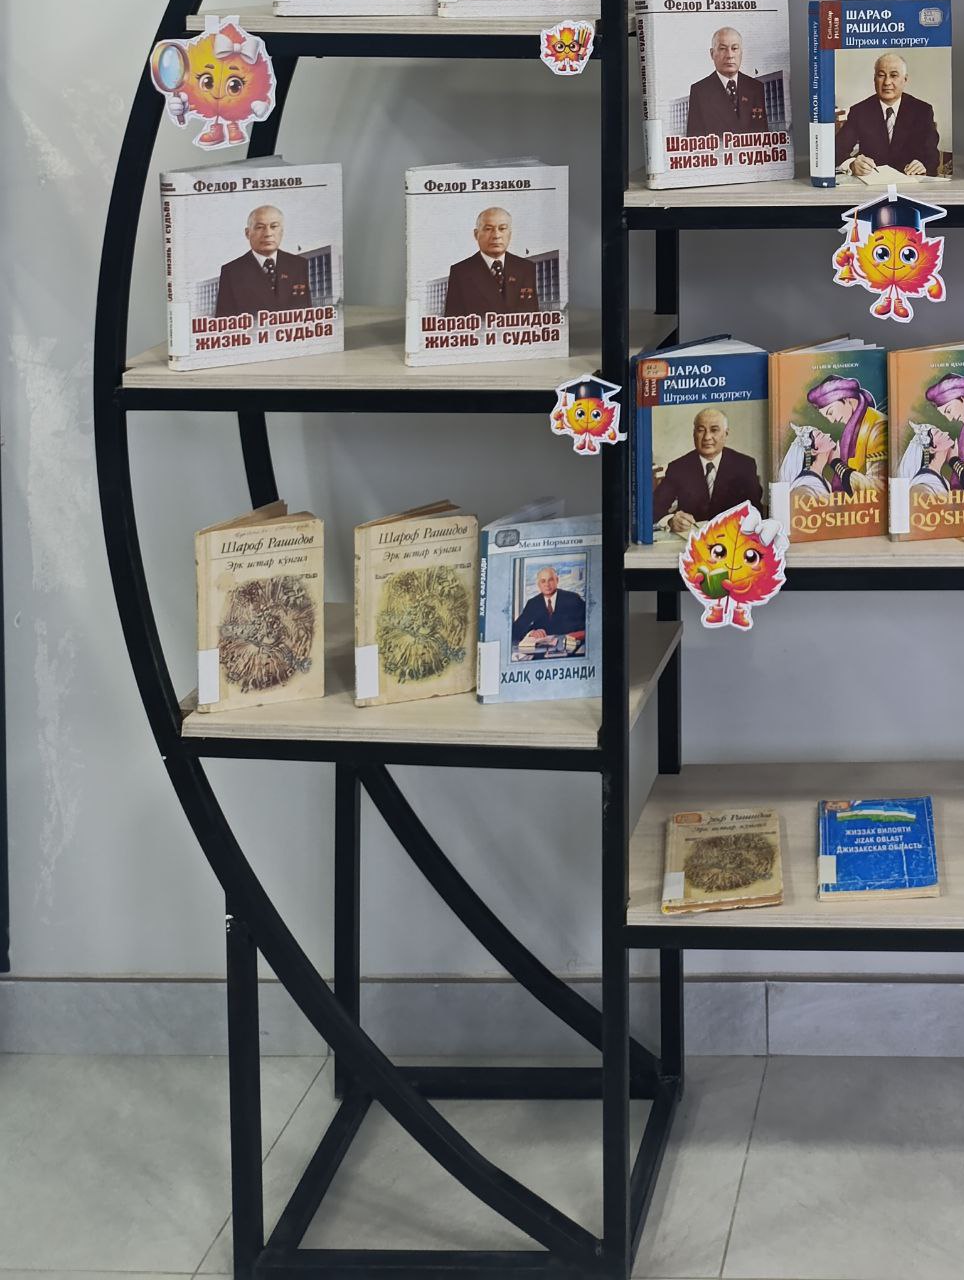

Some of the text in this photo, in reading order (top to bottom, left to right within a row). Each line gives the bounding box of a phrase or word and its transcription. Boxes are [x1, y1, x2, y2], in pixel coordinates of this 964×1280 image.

[846, 10, 892, 20] ШАРАФ
[846, 22, 904, 33] РАШИДОВ
[846, 36, 878, 48] Штрихи
[891, 36, 929, 47] портрету
[666, 134, 718, 152] Шараф
[670, 147, 787, 169] жизнь и судьба
[194, 177, 302, 192] Федор Раззаков
[425, 179, 531, 192] Федор Раззаков
[192, 313, 252, 333] Шараф
[422, 314, 479, 331] Шараф
[196, 323, 332, 350] жизнь и судьба
[425, 328, 559, 348] жизнь и судьба
[667, 365, 712, 375] ШАРАФ
[664, 377, 726, 389] РАШИДОВ
[664, 391, 698, 403] Штрихи
[711, 391, 752, 401] портрету
[794, 489, 878, 511] KASHMIR
[379, 523, 467, 545] Шароф Рашидов
[221, 533, 314, 554] Шароф Рашидов
[543, 539, 583, 547] Норматов
[384, 552, 399, 562] Эрк
[226, 561, 243, 572] Эрк
[501, 666, 595, 684] ХАЛҚ ФАРЗАНДИ
[837, 845, 886, 853] ДЖИЗАКСКАЯ
